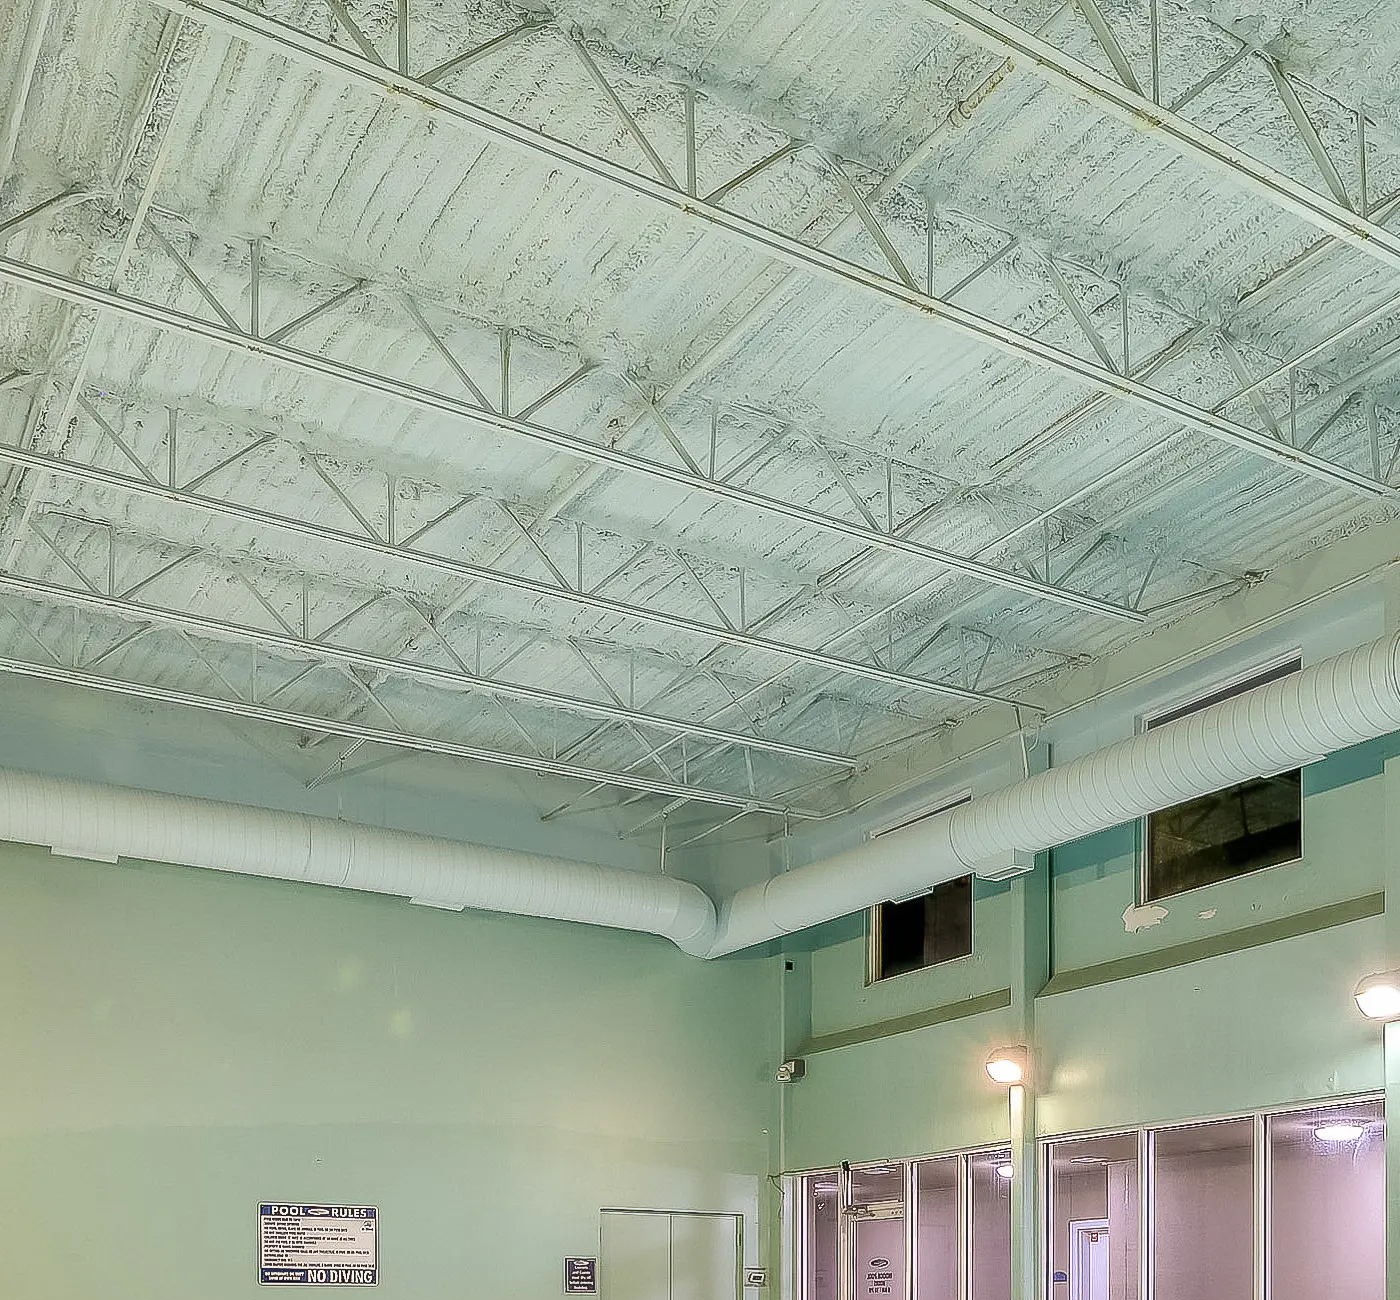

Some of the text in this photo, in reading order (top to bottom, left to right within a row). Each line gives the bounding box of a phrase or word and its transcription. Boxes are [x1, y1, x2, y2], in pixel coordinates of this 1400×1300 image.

[271, 1206, 366, 1217] POOL RULES
[307, 1269, 326, 1283] NO
[329, 1270, 372, 1283] DIVING
